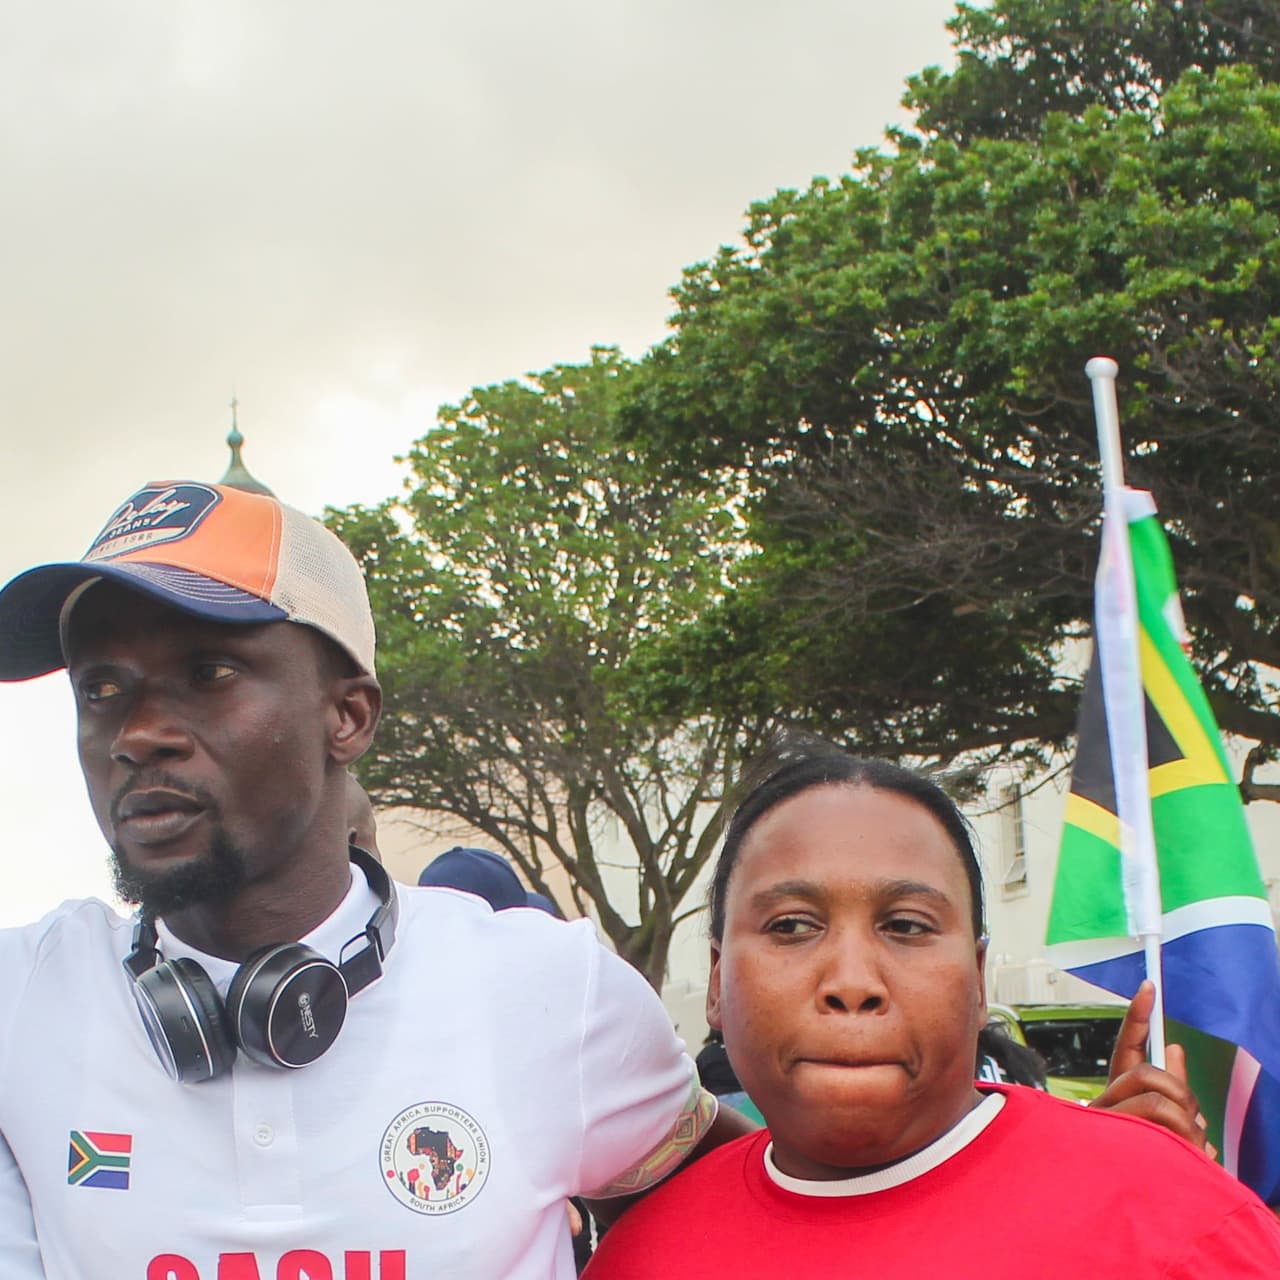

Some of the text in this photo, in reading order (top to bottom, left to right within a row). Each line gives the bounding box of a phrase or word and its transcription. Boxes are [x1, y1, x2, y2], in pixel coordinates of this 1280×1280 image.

[384, 1106, 487, 1163] GREAT AFRICA SUPPORTERS UNION
[410, 1195, 466, 1212] SOUTH AFRICA
